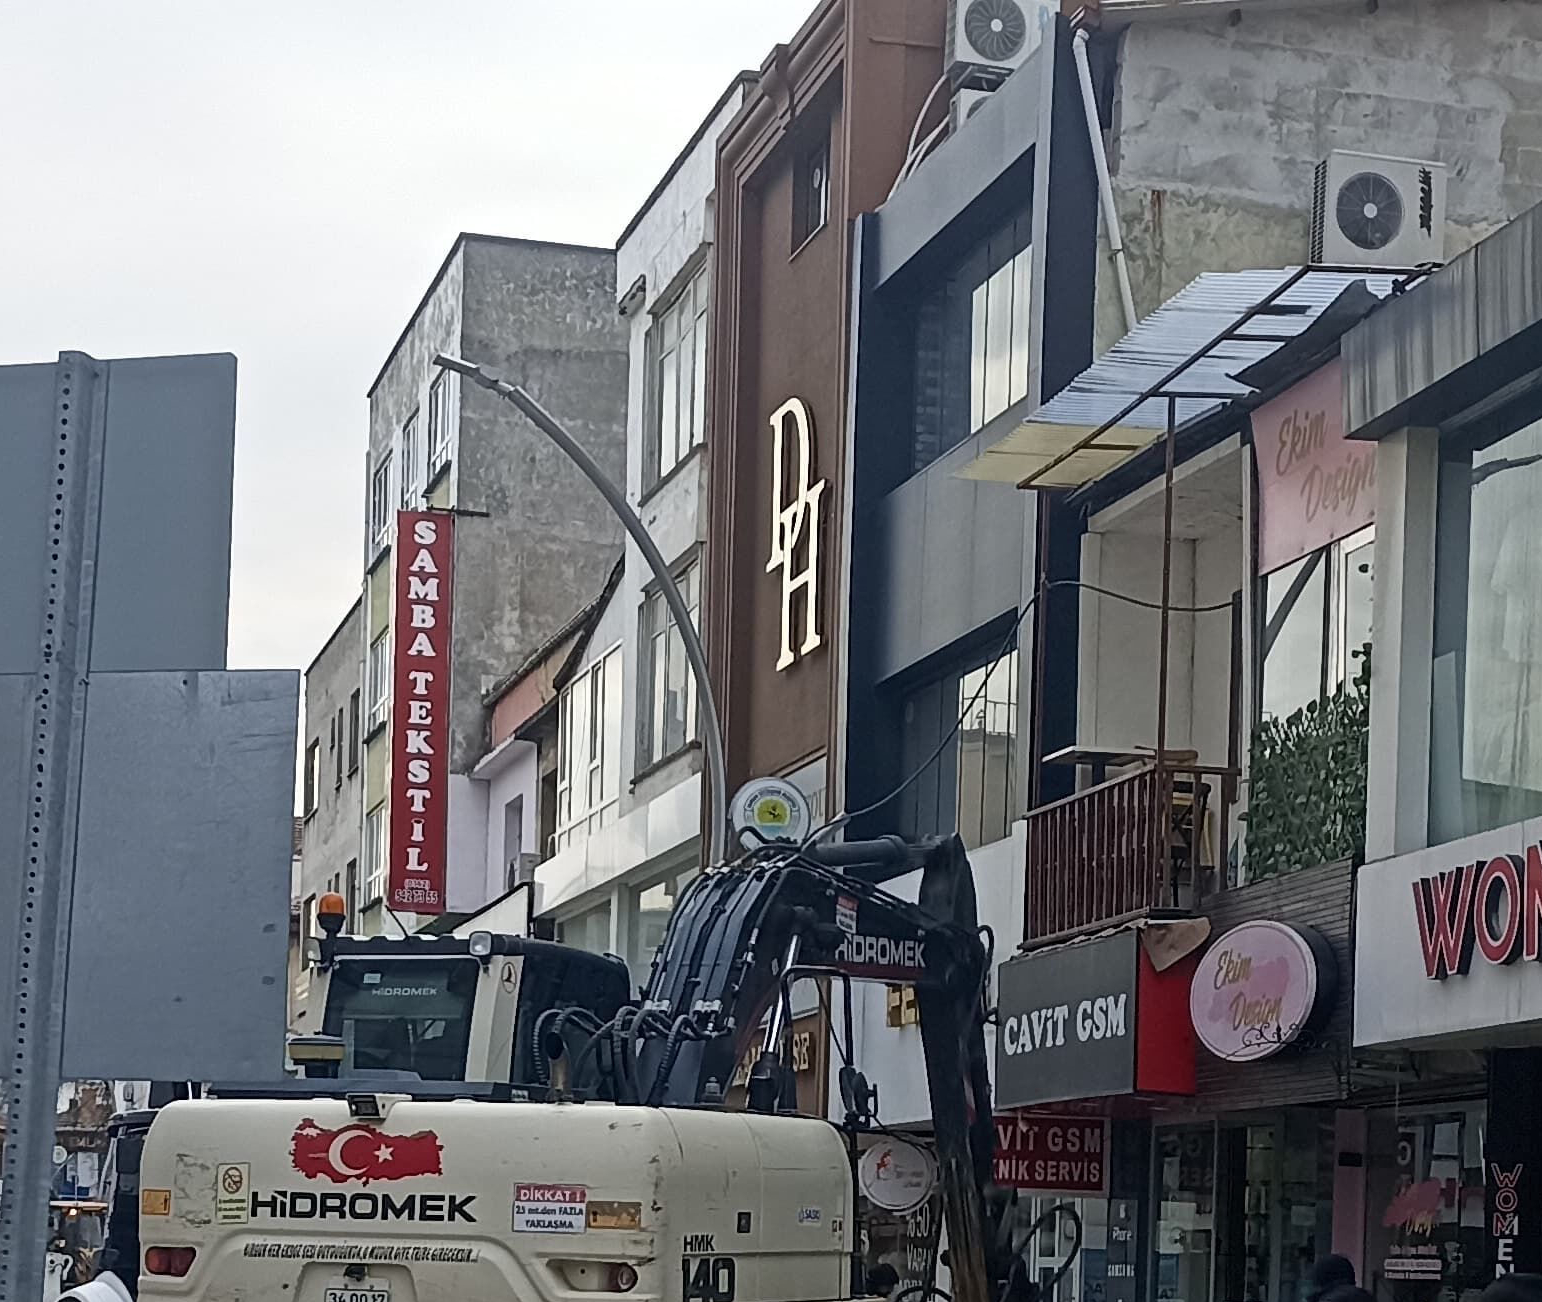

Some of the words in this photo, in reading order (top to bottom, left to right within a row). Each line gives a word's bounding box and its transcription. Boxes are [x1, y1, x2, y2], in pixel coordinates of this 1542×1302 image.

[407, 520, 440, 656] SAMBA
[1214, 948, 1252, 990] Ekim
[1076, 993, 1127, 1042] GSM
[1047, 1127, 1101, 1153] GSM
[683, 1234, 715, 1252] HMK
